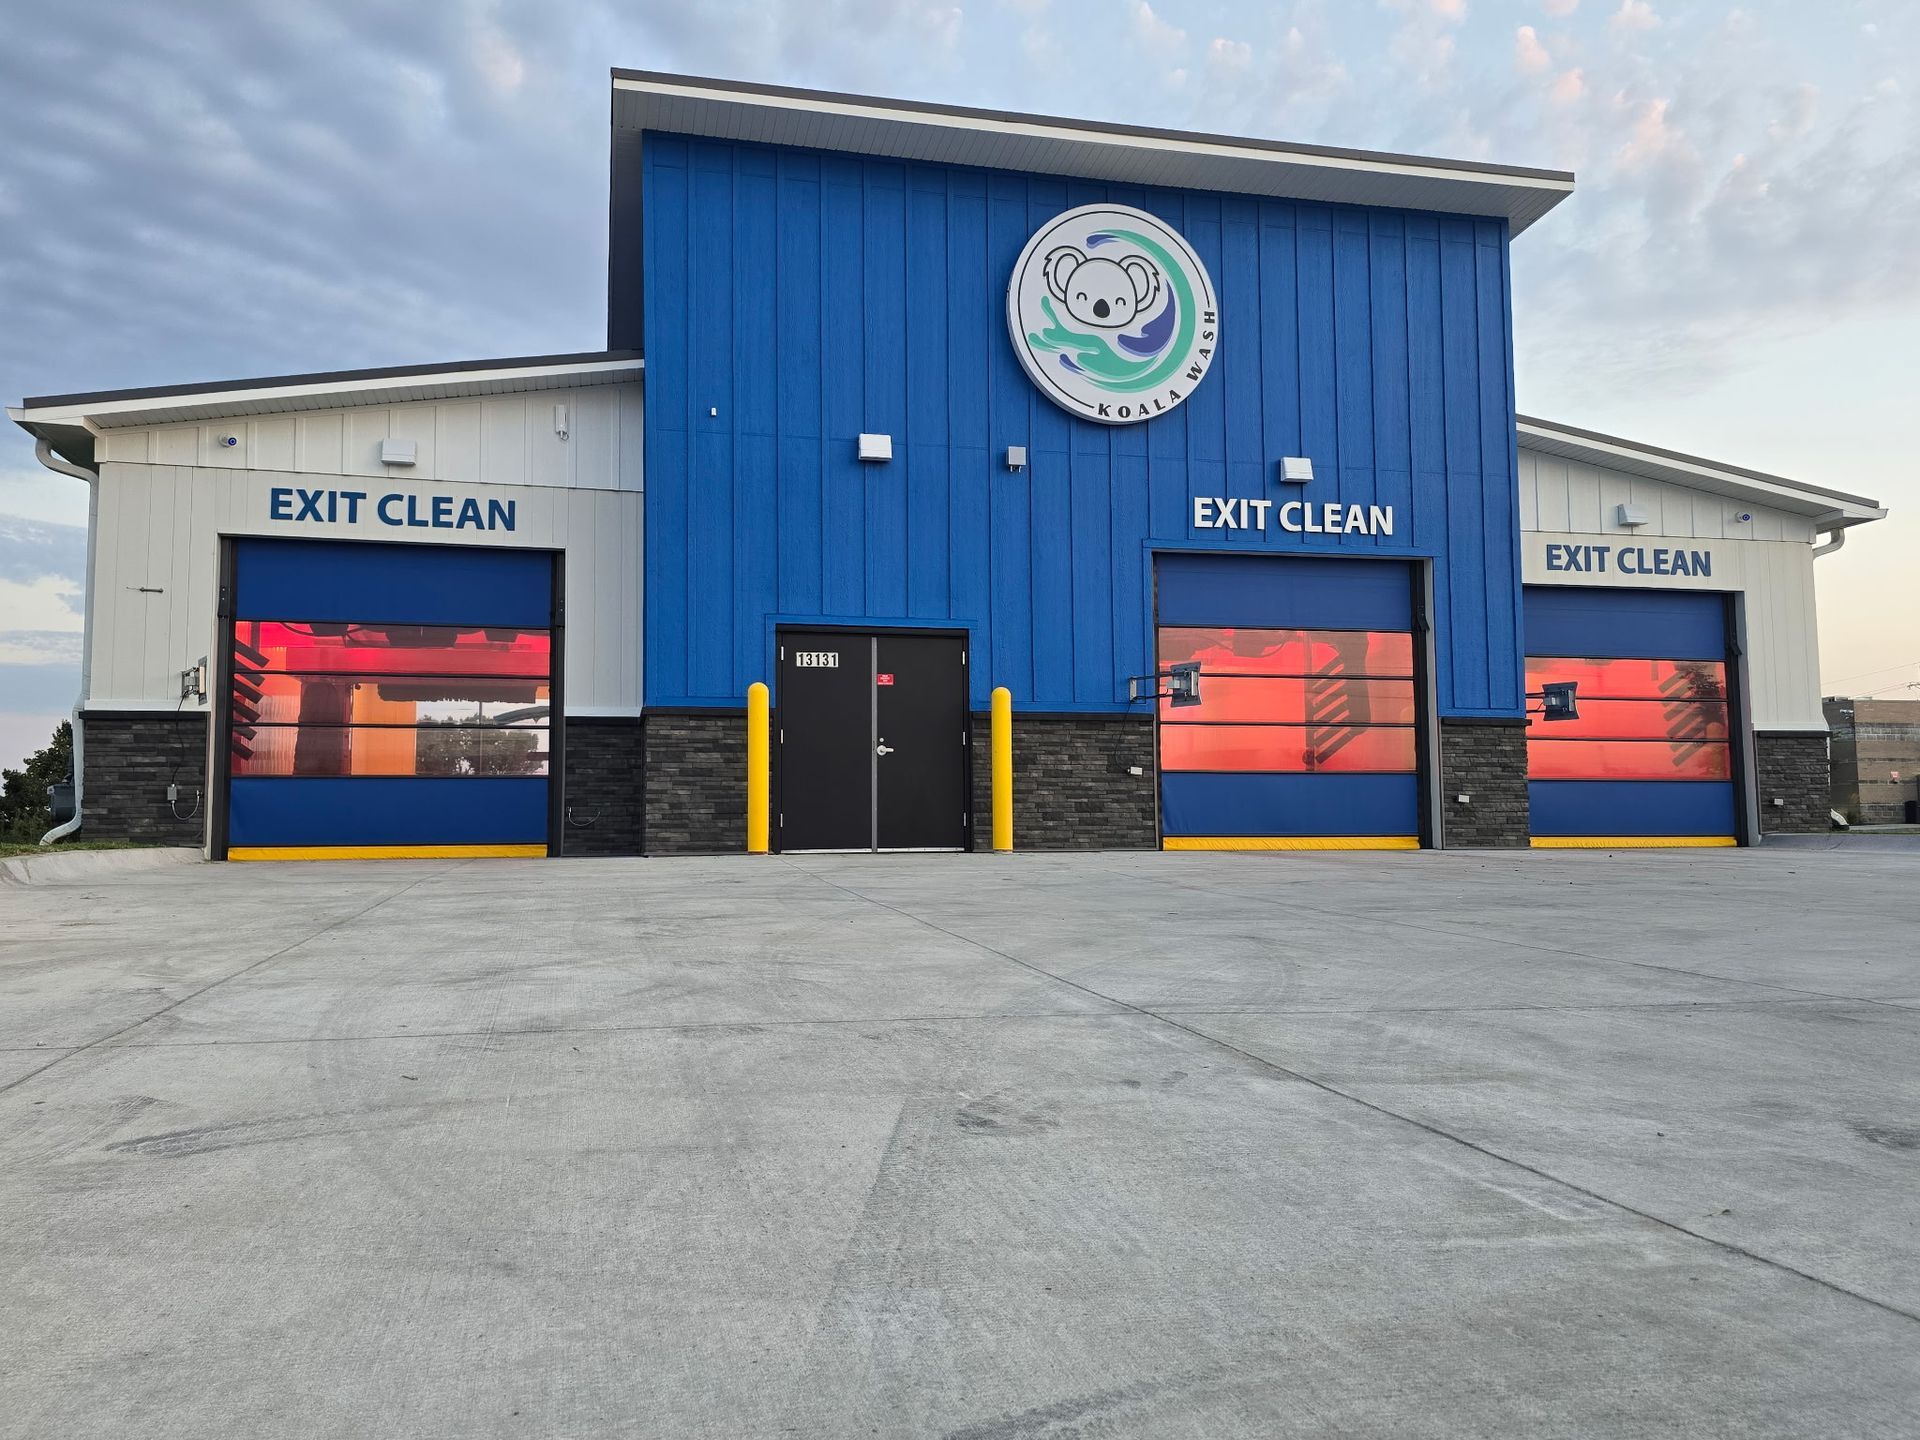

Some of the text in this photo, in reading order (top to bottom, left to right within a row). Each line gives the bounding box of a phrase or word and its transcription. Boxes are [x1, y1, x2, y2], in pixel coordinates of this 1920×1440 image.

[1098, 311, 1216, 418] KOALA WASH
[270, 487, 516, 532] EXIT CLEAN
[1194, 496, 1393, 536] EXIT CLEAN
[1546, 544, 1712, 577] EXIT CLEAN
[798, 653, 837, 666] 13131
